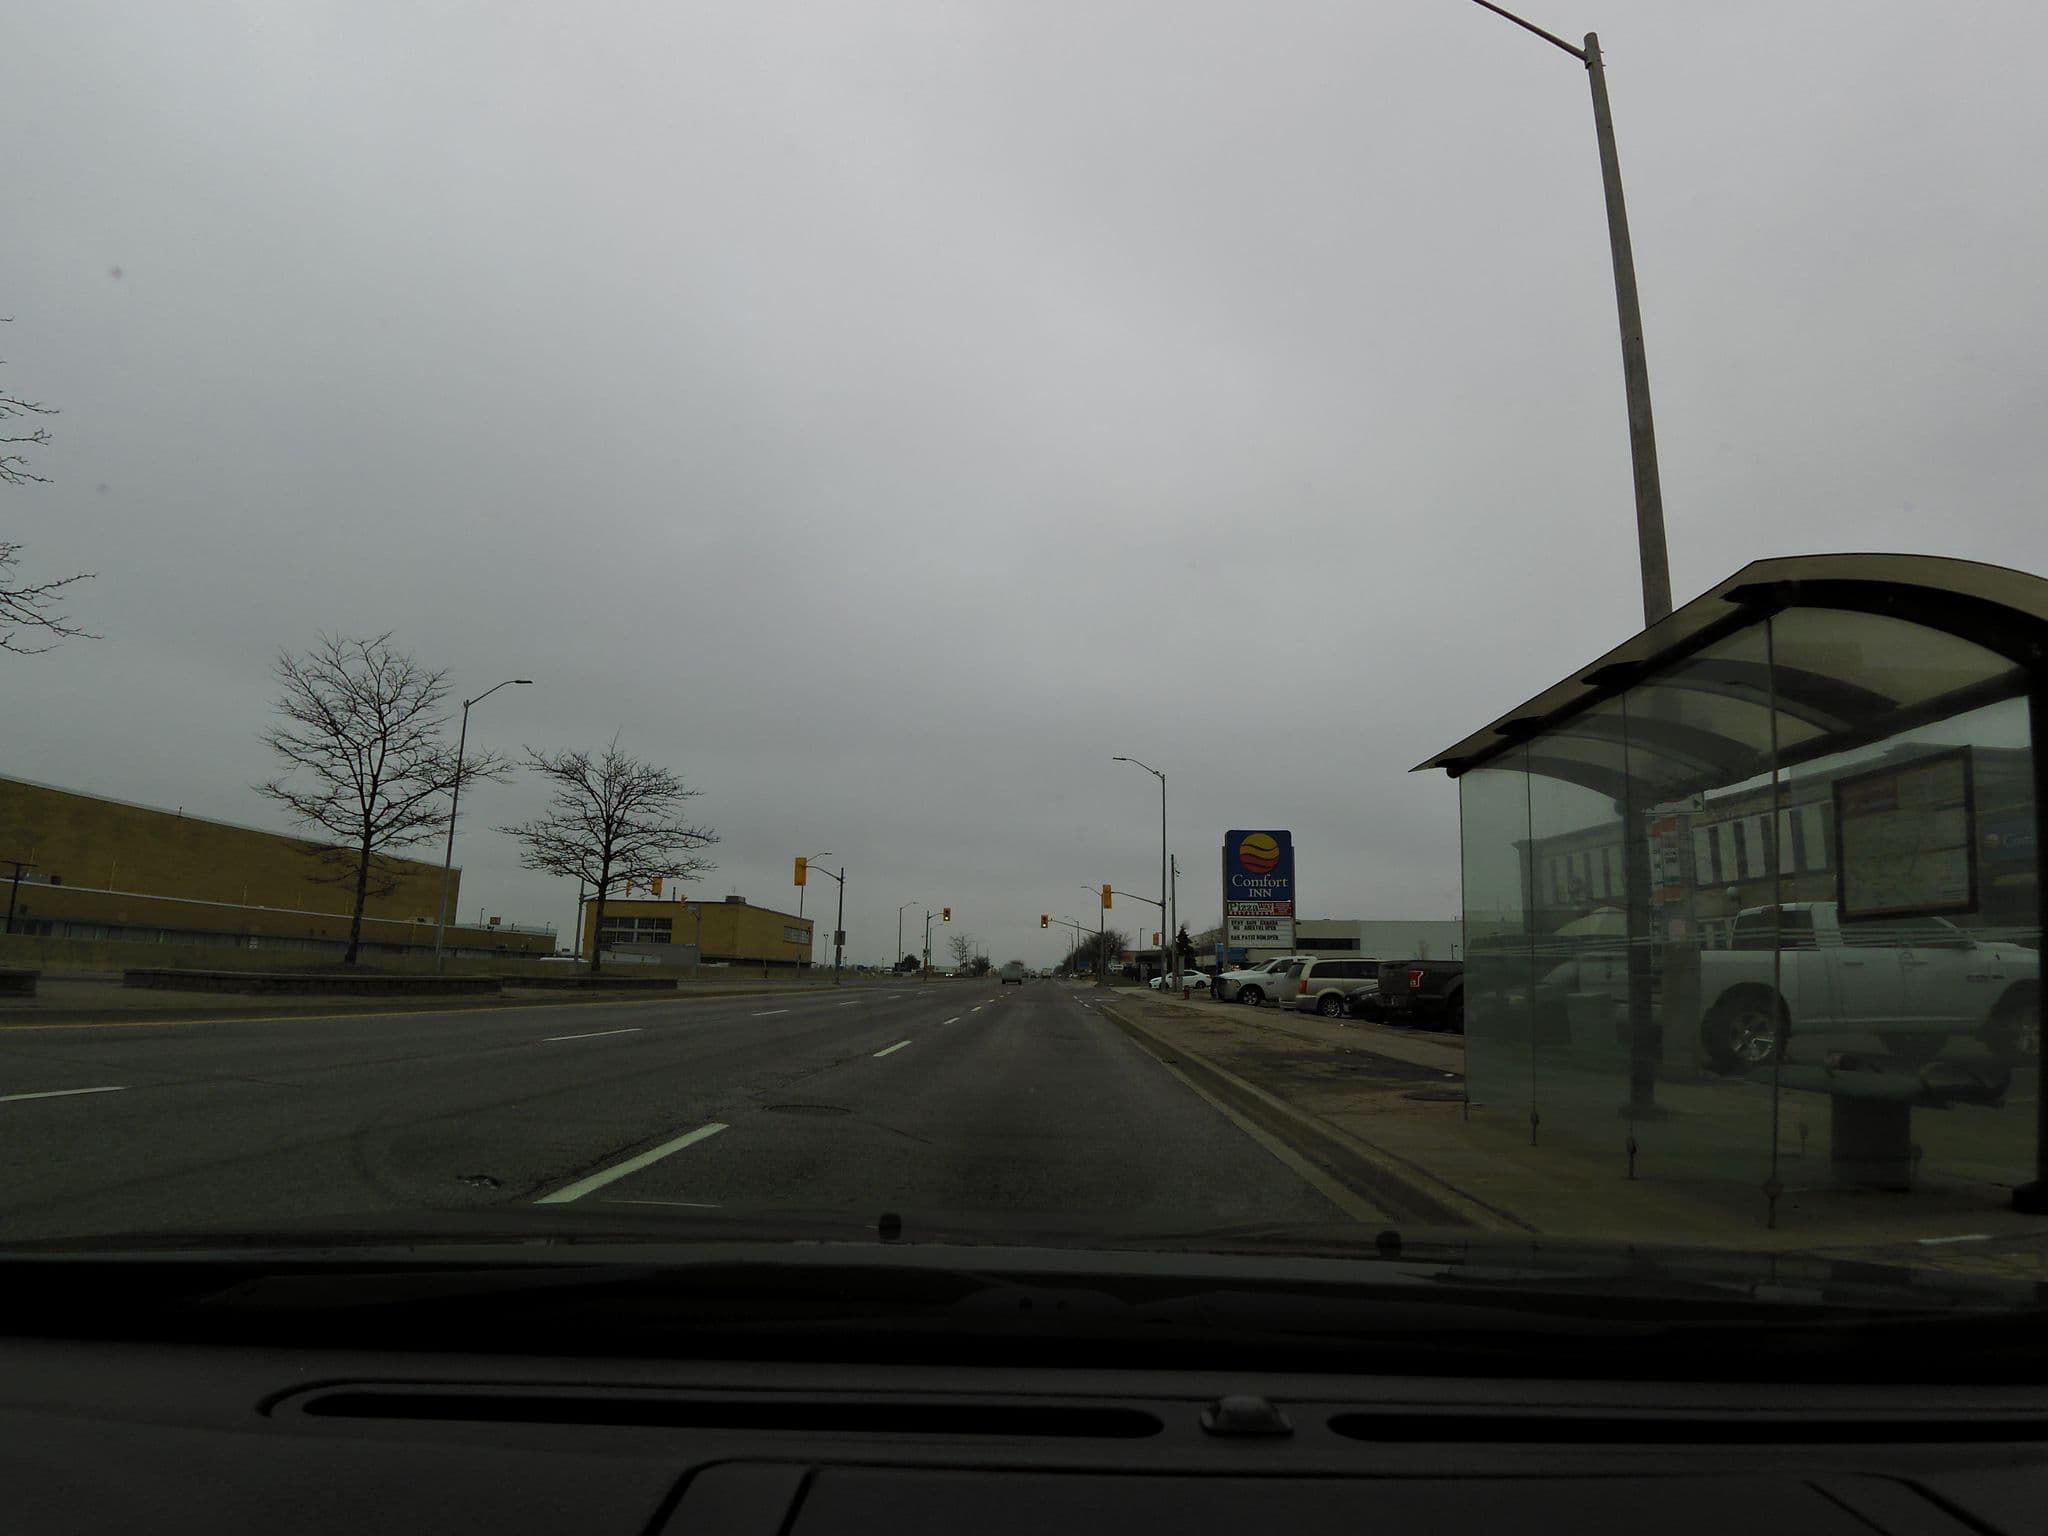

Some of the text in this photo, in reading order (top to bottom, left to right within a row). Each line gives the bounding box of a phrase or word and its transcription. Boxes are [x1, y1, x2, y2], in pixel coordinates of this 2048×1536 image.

[1232, 873, 1289, 887] Comfort
[1249, 888, 1272, 897] INN
[1228, 902, 1258, 912] Pizza
